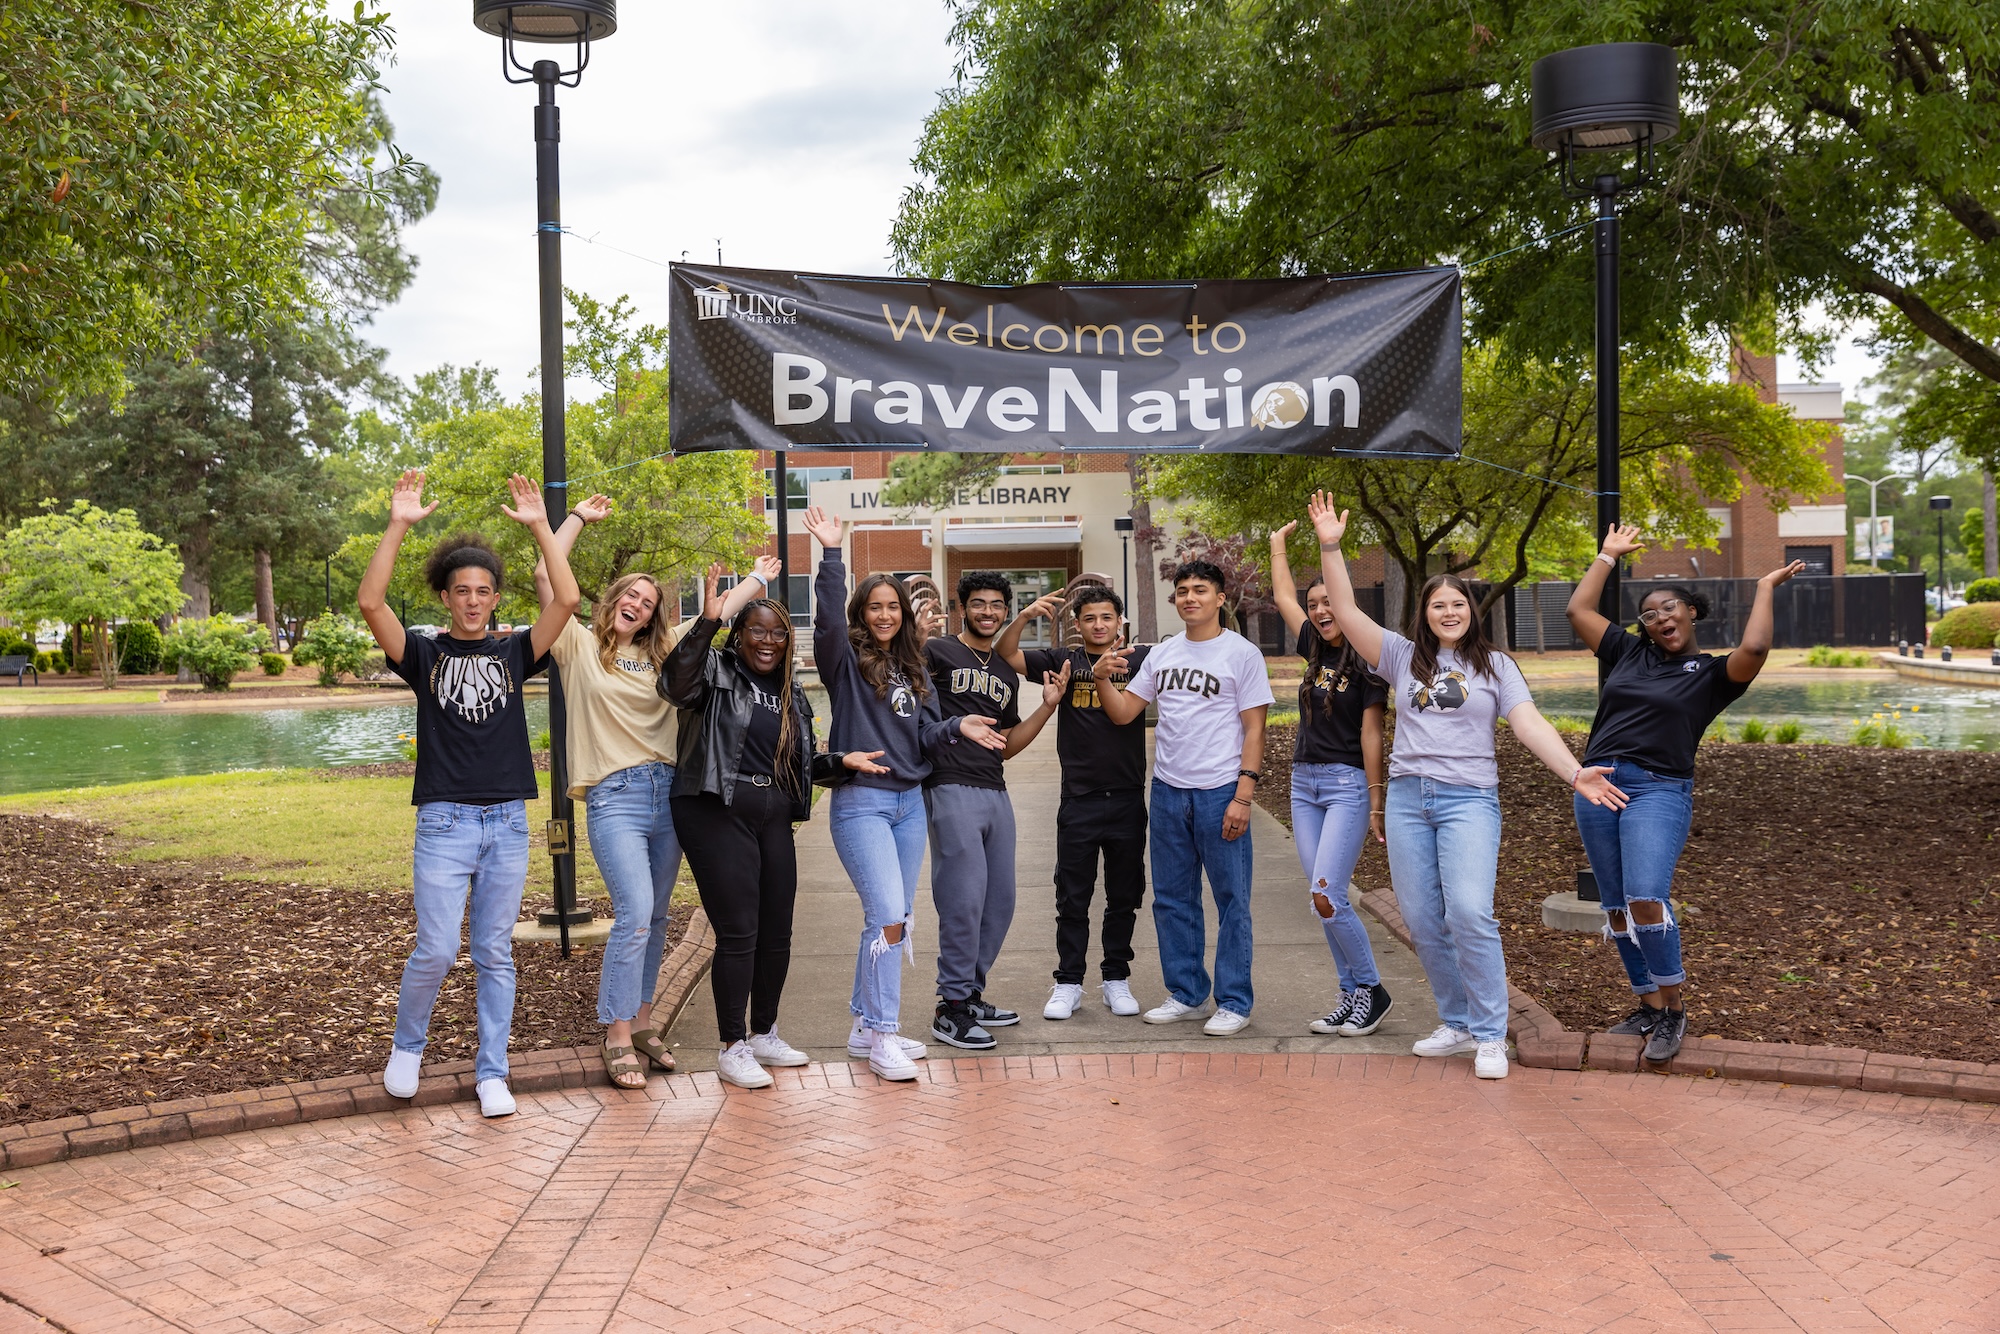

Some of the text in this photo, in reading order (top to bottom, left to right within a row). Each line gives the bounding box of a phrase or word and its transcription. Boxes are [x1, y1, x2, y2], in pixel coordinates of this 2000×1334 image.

[733, 293, 797, 316] UNC
[731, 312, 797, 325] PEMBROKE
[881, 303, 1247, 356] Welcome to
[772, 351, 1361, 433] BraveNation
[977, 486, 1072, 506] LIBRARY
[1155, 668, 1221, 699] UNCP
